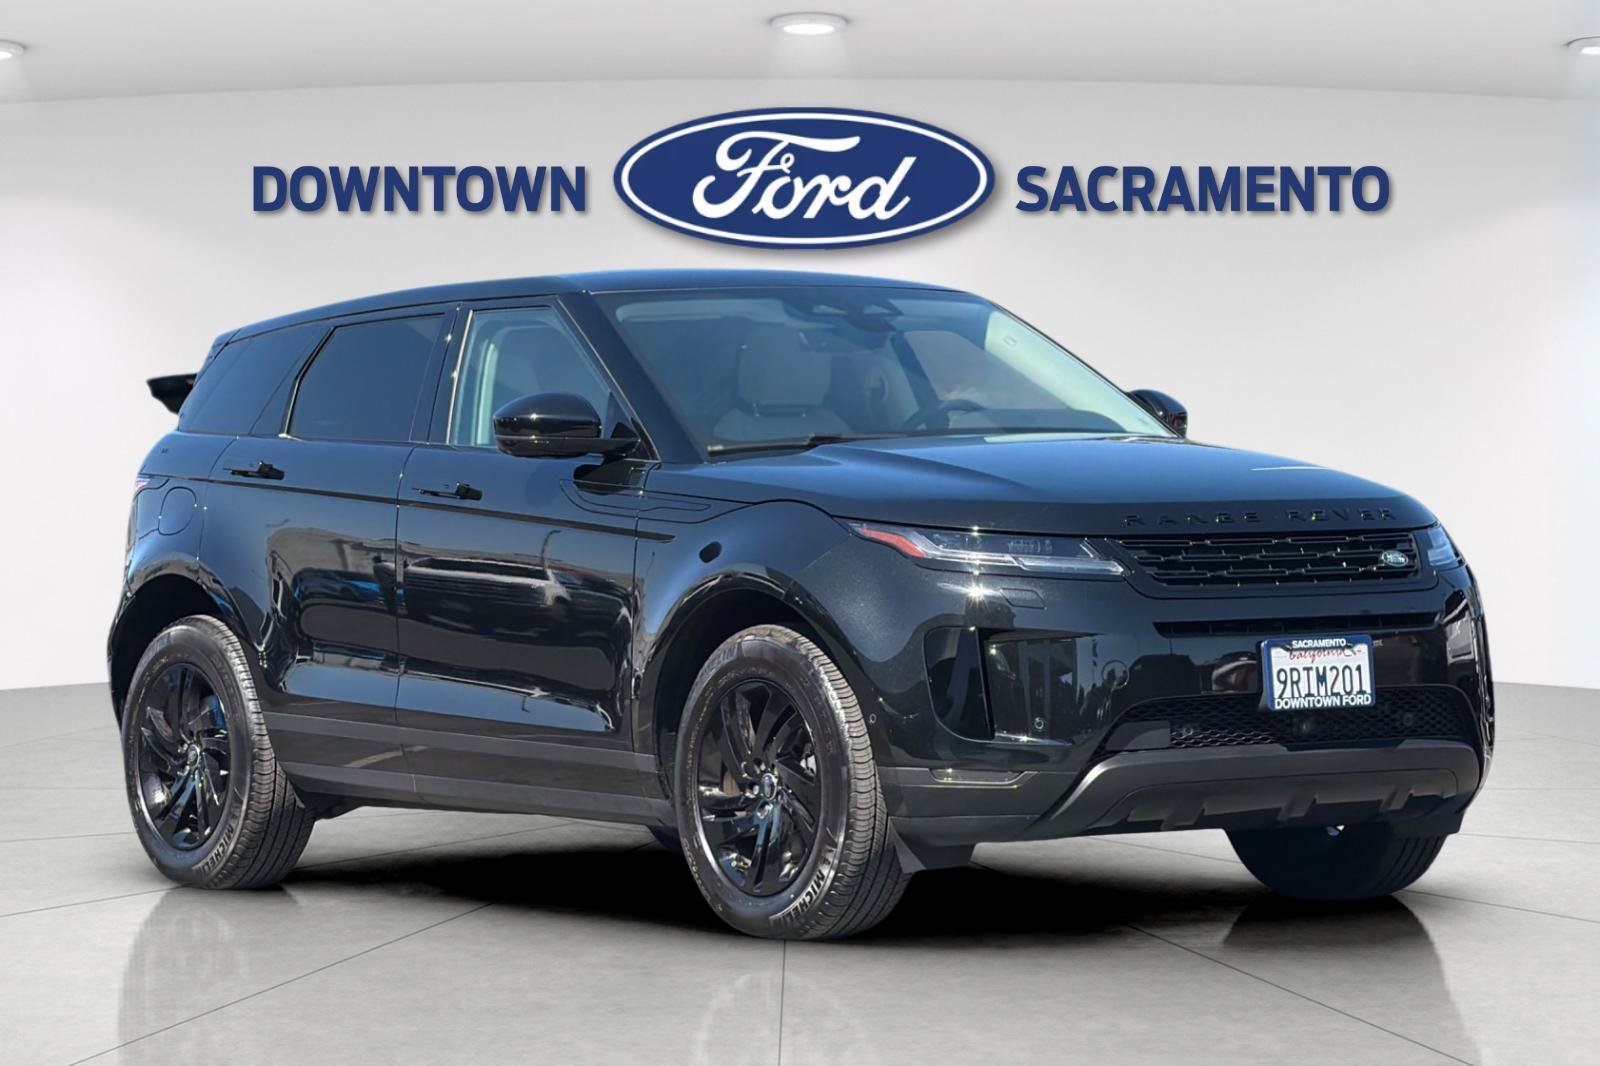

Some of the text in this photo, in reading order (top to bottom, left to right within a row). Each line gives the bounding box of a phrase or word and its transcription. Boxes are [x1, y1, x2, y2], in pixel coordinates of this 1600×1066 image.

[252, 131, 1391, 220] DOWNTOWN Ford SACRAMENTO
[1124, 507, 1398, 527] RANGE ROVER
[1291, 638, 1347, 649] SACRAMENTO
[1276, 664, 1368, 699] 9RIM201
[1274, 694, 1372, 710] DOWNTOWN FORD
[770, 869, 826, 924] MICHEL
